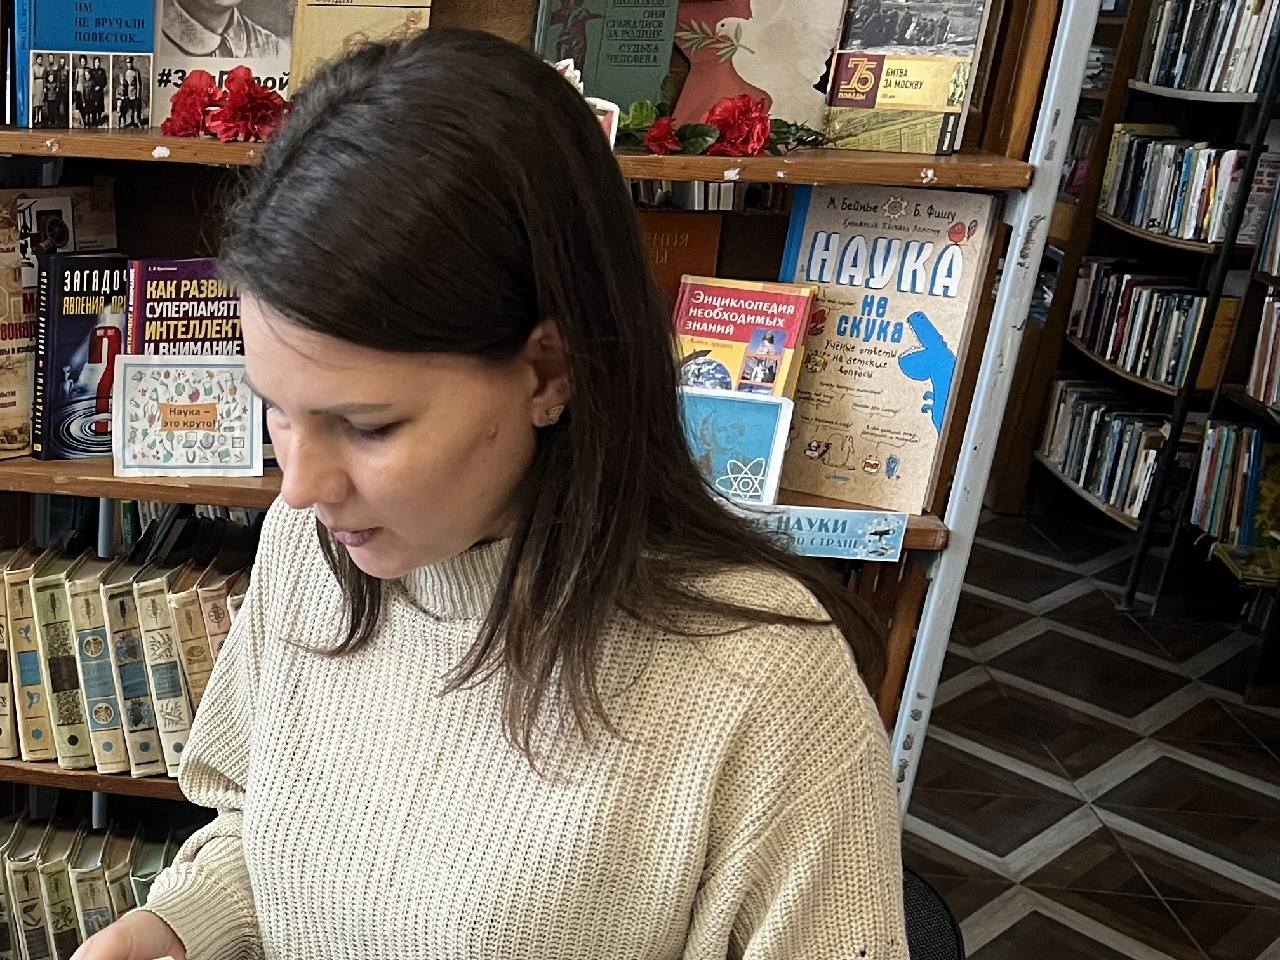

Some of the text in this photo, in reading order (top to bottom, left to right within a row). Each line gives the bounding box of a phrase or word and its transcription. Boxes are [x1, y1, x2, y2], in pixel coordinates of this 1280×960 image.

[643, 10, 665, 18] ОНИ
[74, 17, 145, 29] НЕ ВРУЧАЛИ
[606, 30, 662, 39] ЗА РОДИНУ
[619, 44, 659, 53] СУДЬБА
[606, 54, 658, 63] ЧЕЛОВЕКА
[840, 57, 877, 93] 75
[885, 68, 908, 78] БИТВА
[883, 79, 924, 90] ЗА МОСКВУ
[841, 197, 879, 213] Бейнье
[926, 204, 956, 224] Фишу
[806, 231, 963, 298] НАУКА
[63, 269, 127, 295] ЗАГАДО
[146, 280, 177, 299] КАК
[63, 295, 105, 316] ЯВЛЕНИЯ
[144, 319, 243, 341] ИНТЕЛЛЕКТ
[836, 314, 904, 344] скука
[144, 341, 243, 356] И ВНИМАНИЕ
[169, 407, 201, 417] Наука
[163, 419, 216, 430] это круто!
[777, 516, 848, 534] НАУКИ
